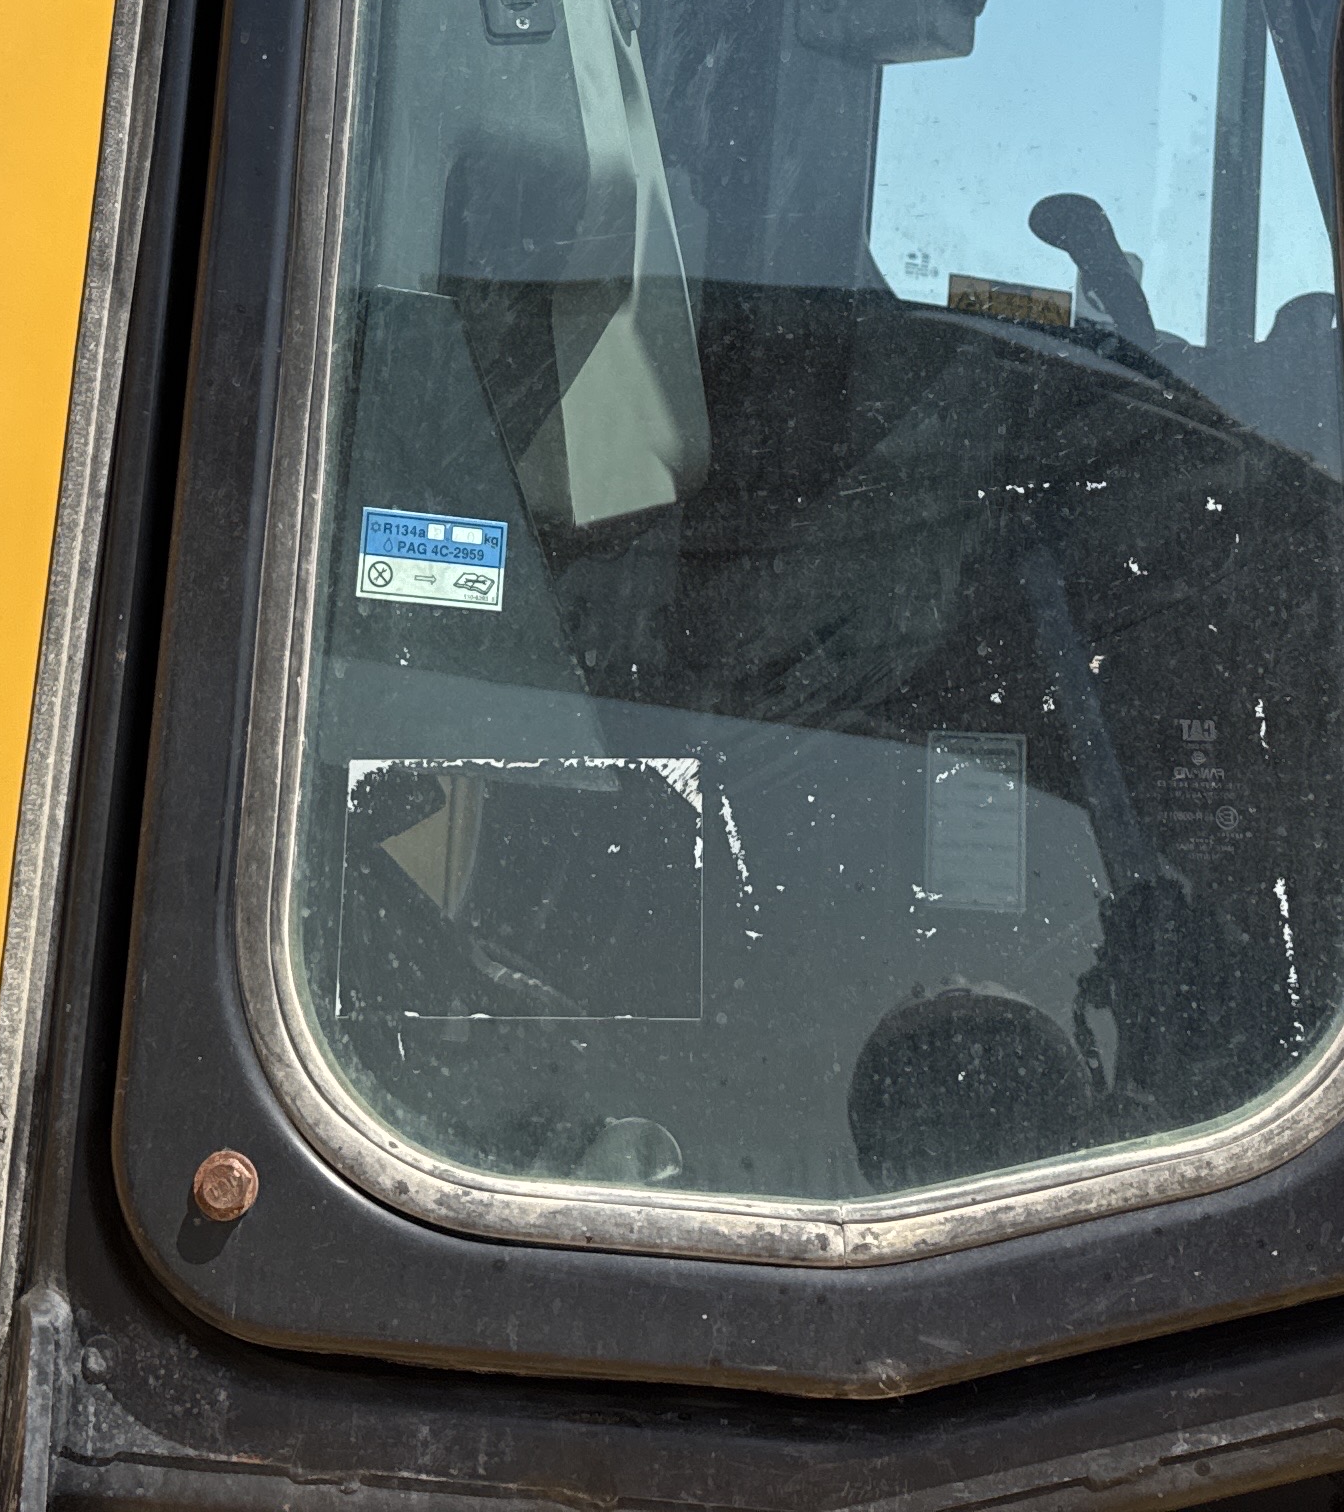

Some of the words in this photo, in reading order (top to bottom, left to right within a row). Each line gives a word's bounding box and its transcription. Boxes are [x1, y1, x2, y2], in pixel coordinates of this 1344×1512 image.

[383, 523, 426, 538] R134a
[484, 534, 498, 548] kg
[398, 542, 427, 555] PAG
[432, 545, 484, 561] 4C-2959
